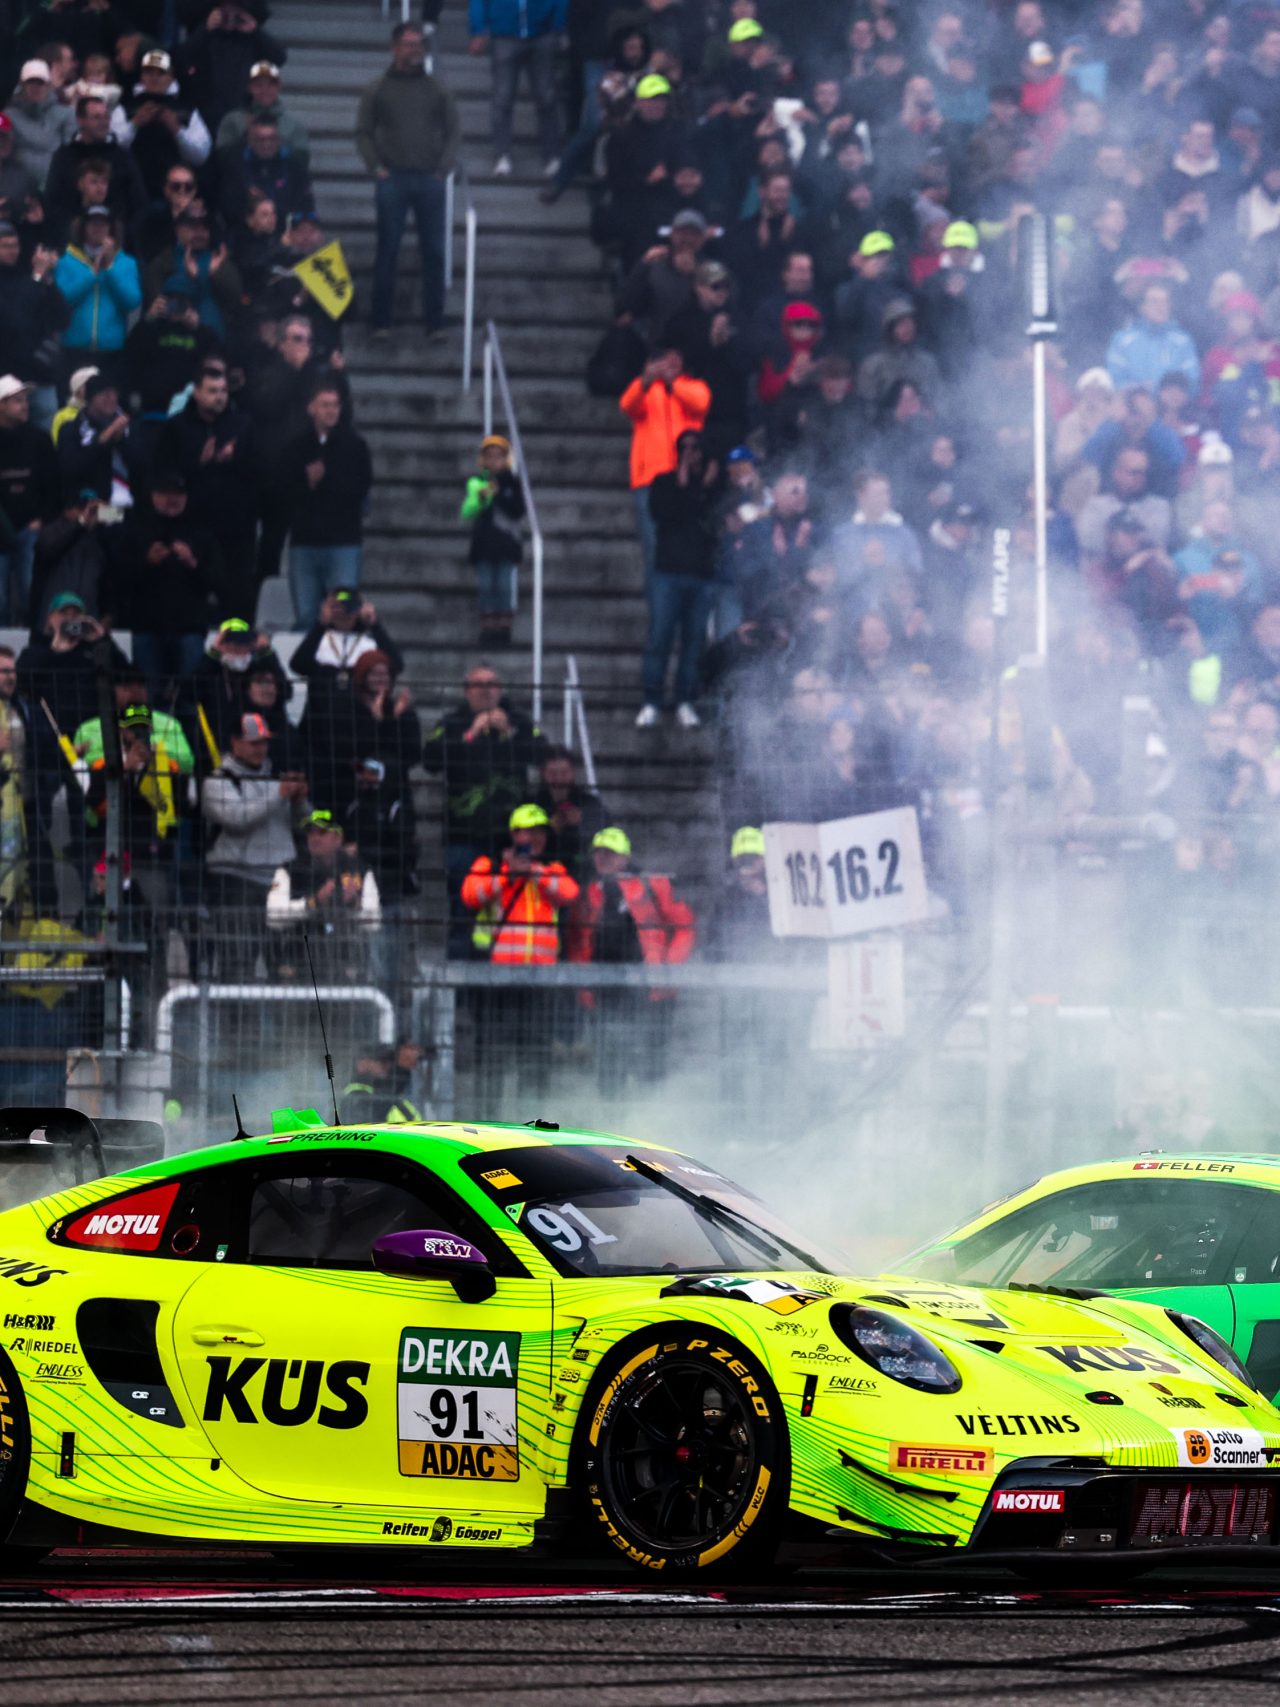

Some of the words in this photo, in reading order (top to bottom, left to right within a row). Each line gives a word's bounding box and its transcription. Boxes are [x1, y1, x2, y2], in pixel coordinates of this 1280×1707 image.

[827, 839, 903, 905] 16.2
[290, 1133, 377, 1143] PREINING
[485, 1168, 510, 1180] ADAC
[1158, 1162, 1235, 1173] FELLER
[84, 1215, 160, 1235] MOTUL
[527, 1203, 617, 1251] 91
[33, 1341, 78, 1354] RIEDEL
[402, 1337, 514, 1378] DEKRA
[791, 1350, 852, 1364] PADDOCK
[36, 1363, 84, 1377] ENDLESS
[686, 1339, 709, 1350] P
[710, 1347, 770, 1417] ZERO
[202, 1356, 371, 1430] KÜS
[829, 1376, 877, 1389] ENDLESS
[429, 1388, 484, 1439] 91
[595, 1402, 605, 1426] DTM
[955, 1414, 1081, 1436] VELTINS
[1207, 1430, 1243, 1445] Lotto
[421, 1443, 495, 1478] ADAC
[897, 1447, 986, 1471] PIRELLI
[1213, 1447, 1260, 1464] Scanner
[751, 1486, 765, 1509] DTM
[996, 1494, 1061, 1510] MOTUL
[1134, 1488, 1270, 1537] MOTUL
[382, 1521, 429, 1537] Reifen
[455, 1525, 502, 1541] Göggel
[592, 1498, 667, 1570] PIRELLI
